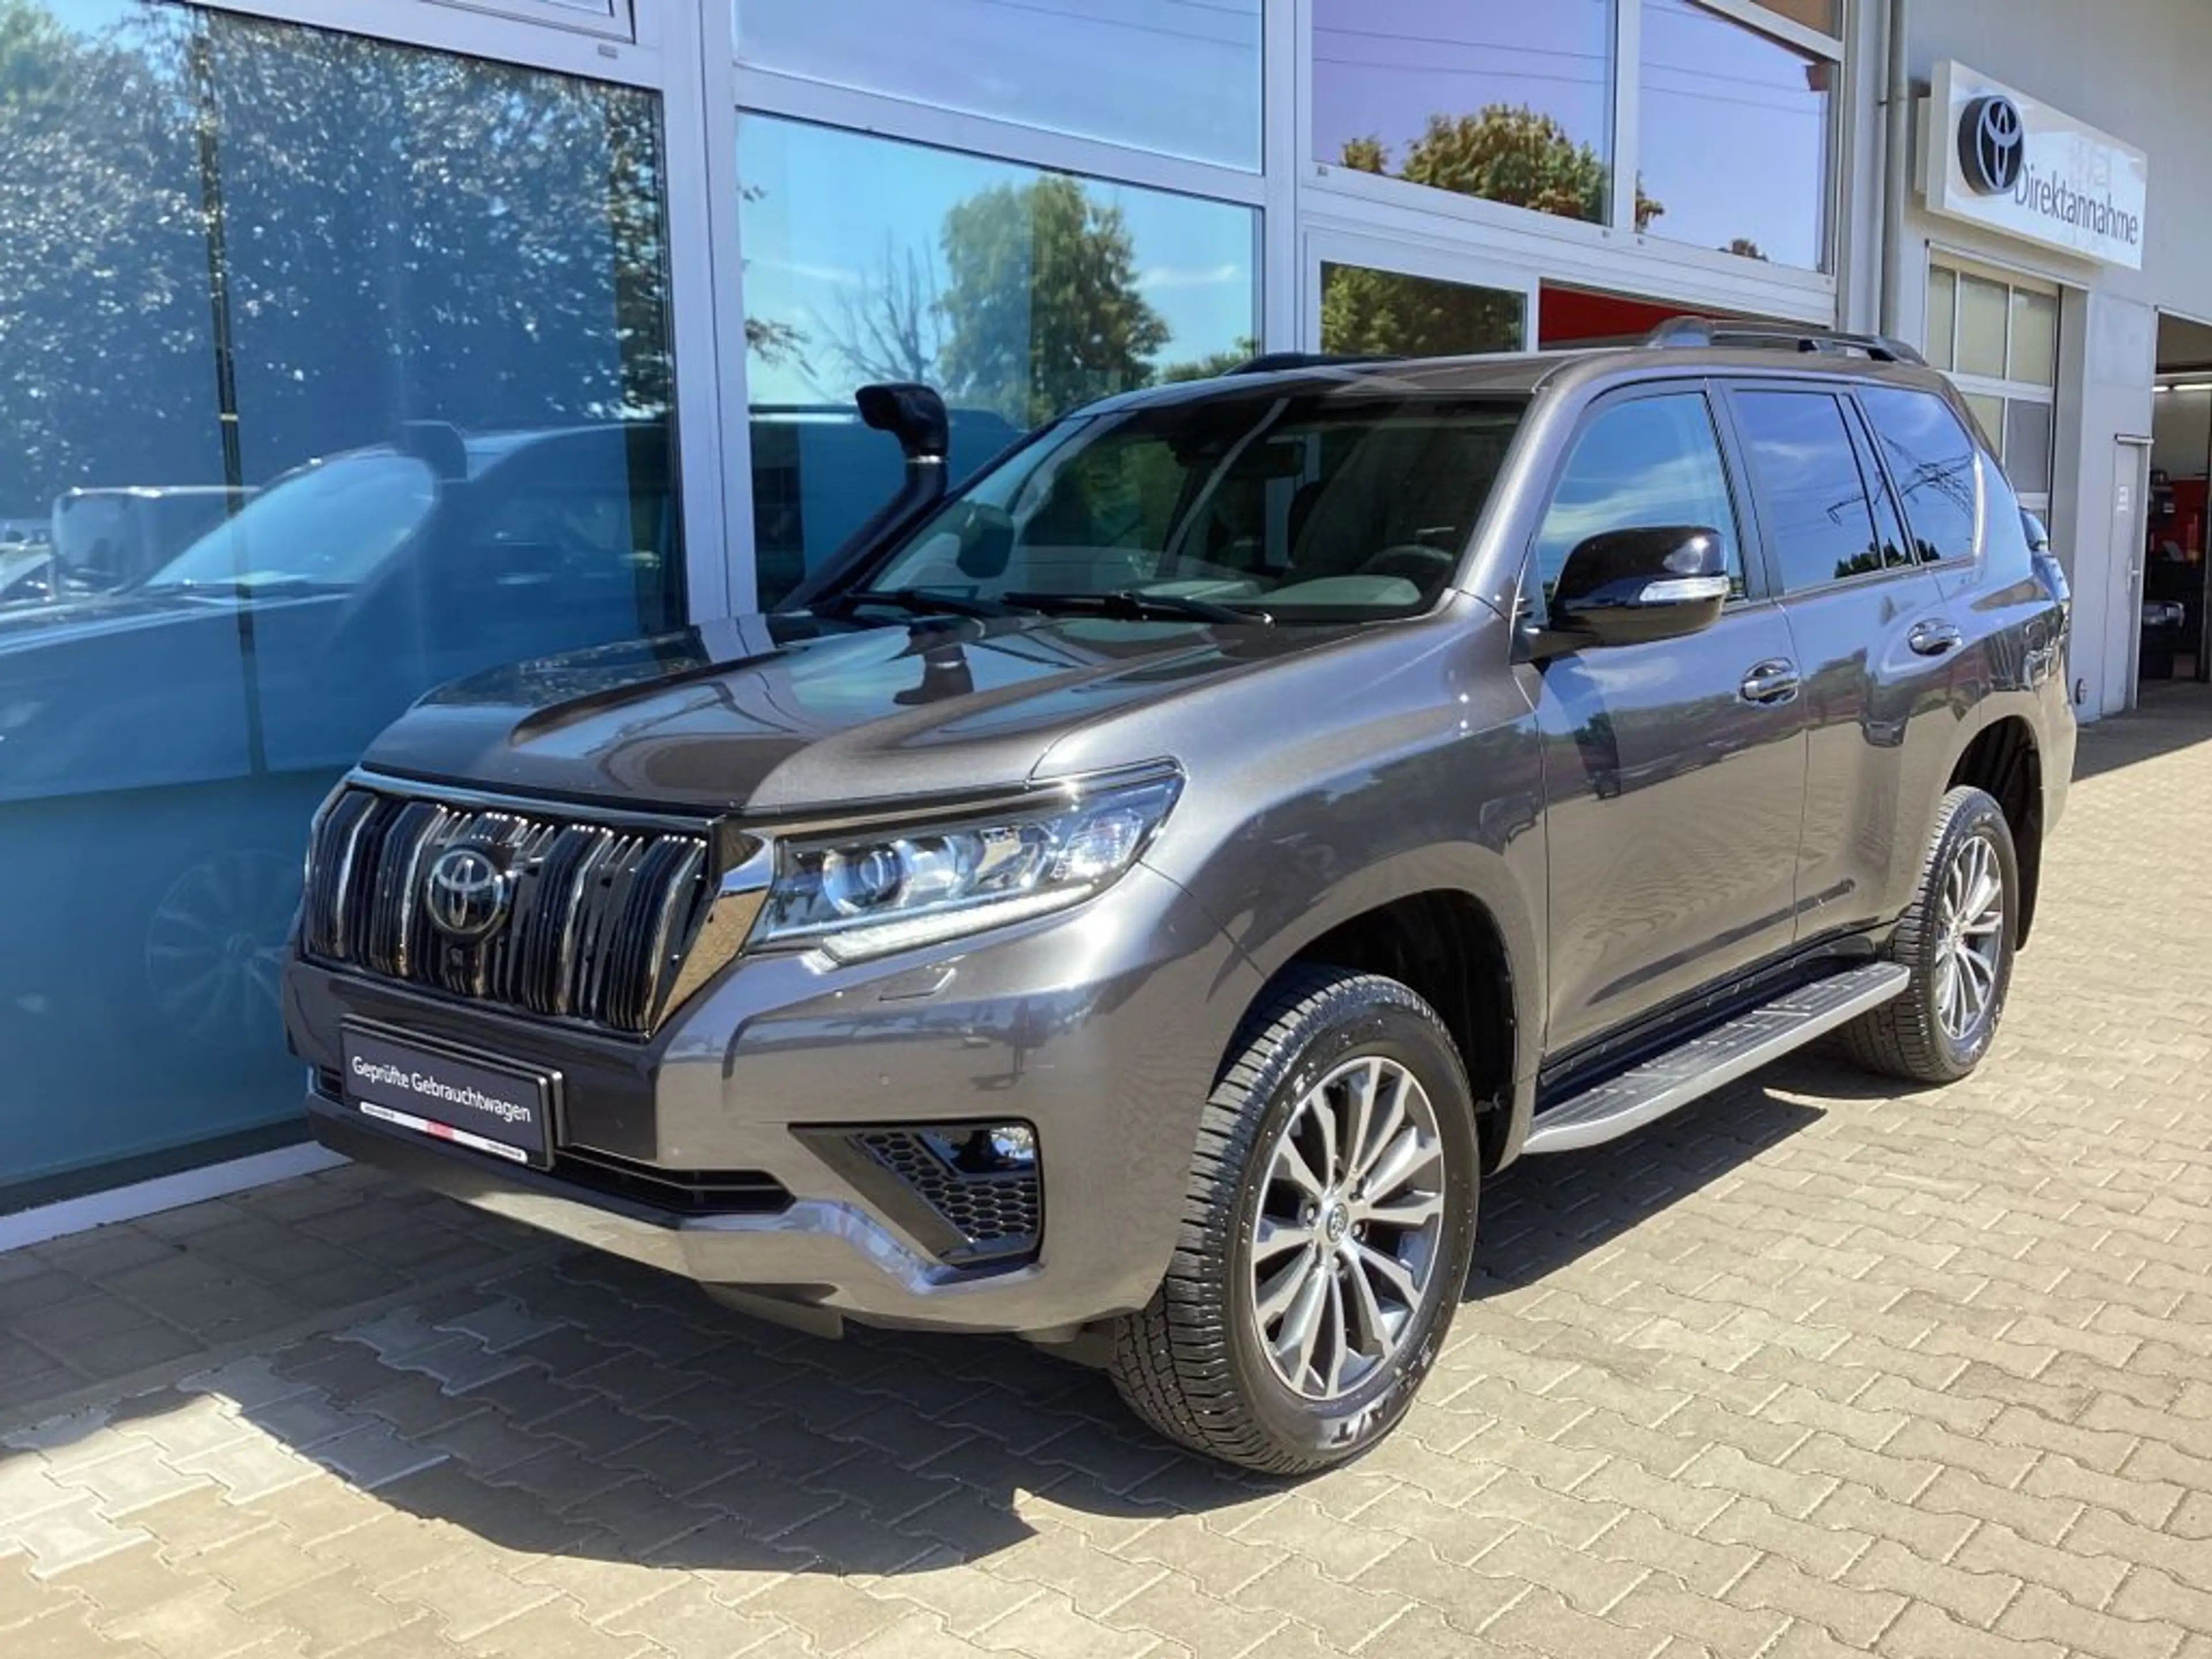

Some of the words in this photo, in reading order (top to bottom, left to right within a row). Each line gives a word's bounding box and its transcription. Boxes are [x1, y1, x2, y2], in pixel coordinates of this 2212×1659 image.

[2014, 164, 2138, 245] Direktannahme
[352, 1056, 409, 1089] Geprüfte
[411, 1072, 532, 1123] Gebrauchtwagen
